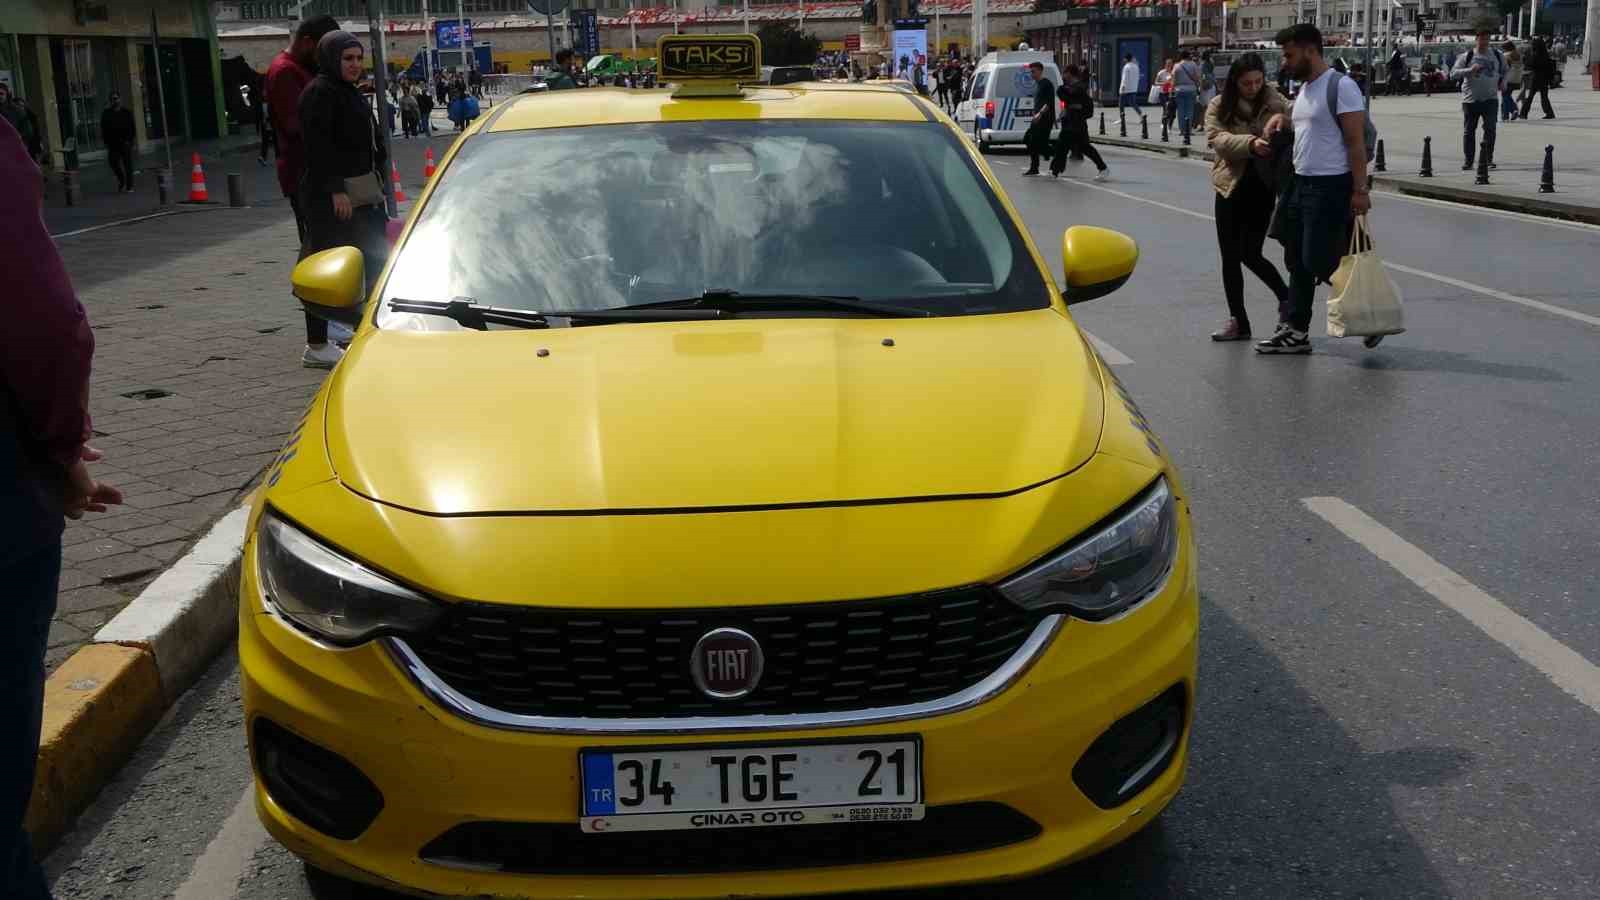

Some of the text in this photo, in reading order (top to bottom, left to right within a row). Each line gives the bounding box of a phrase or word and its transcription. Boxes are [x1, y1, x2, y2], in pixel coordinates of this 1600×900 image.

[707, 648, 749, 681] FIAT
[617, 748, 905, 807] 34 TGE 21
[591, 788, 612, 803] TR
[761, 810, 805, 823] OTO
